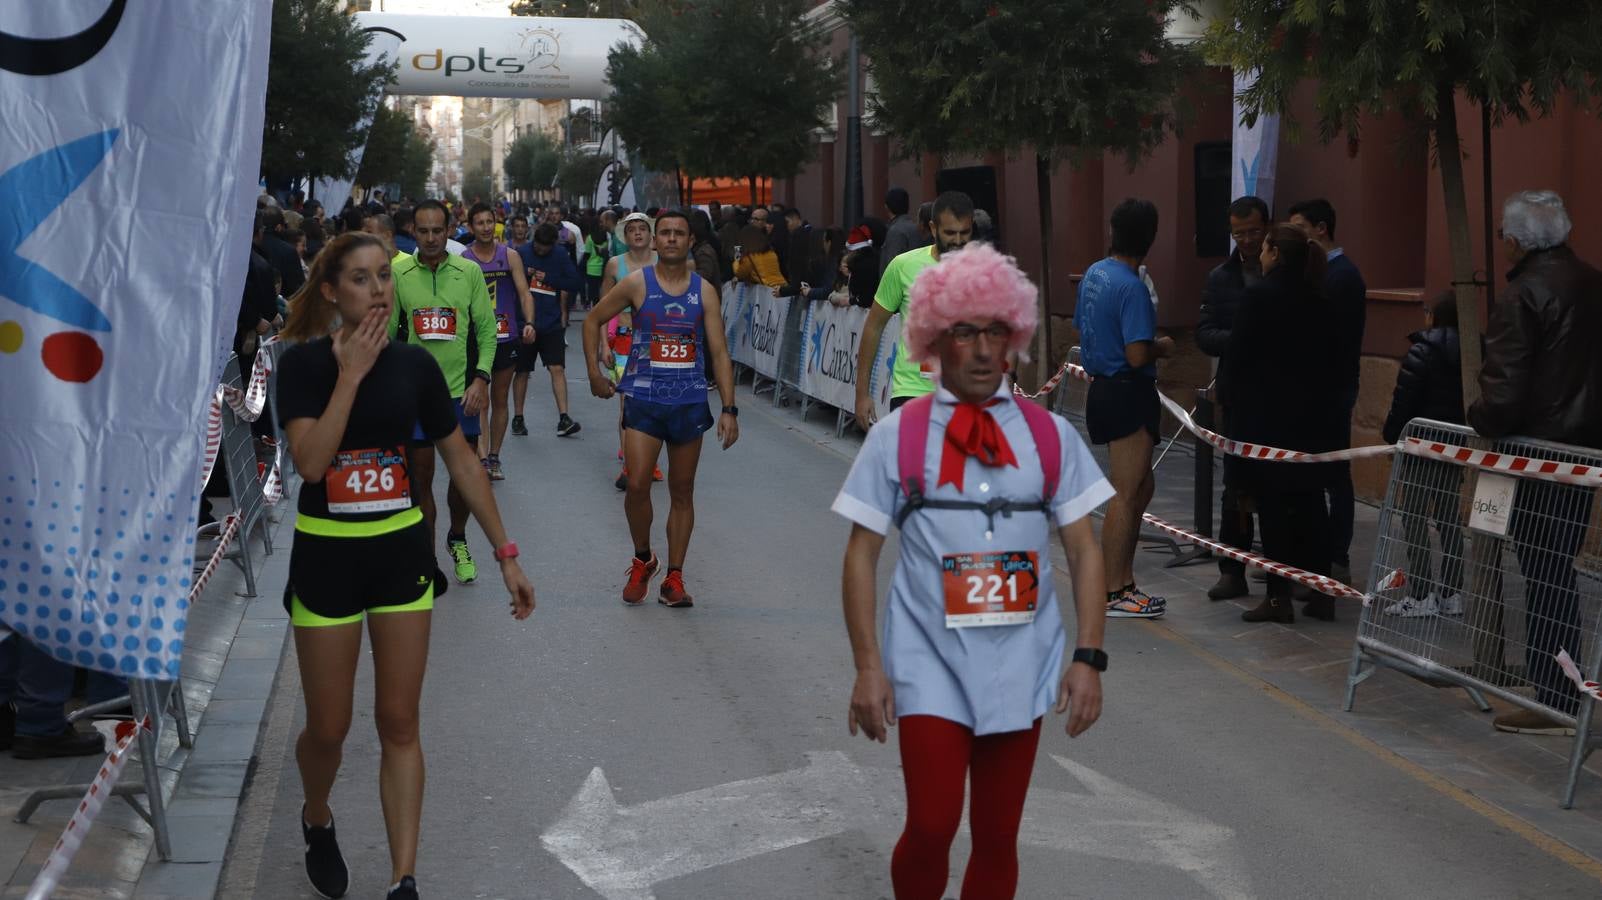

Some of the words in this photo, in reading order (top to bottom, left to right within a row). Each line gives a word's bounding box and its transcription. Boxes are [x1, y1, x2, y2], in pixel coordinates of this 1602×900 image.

[412, 47, 525, 77] dpts
[422, 317, 448, 330] 380
[661, 344, 688, 358] 525
[345, 467, 395, 494] 426
[1473, 498, 1498, 515] dpts
[966, 574, 1018, 604] 221
